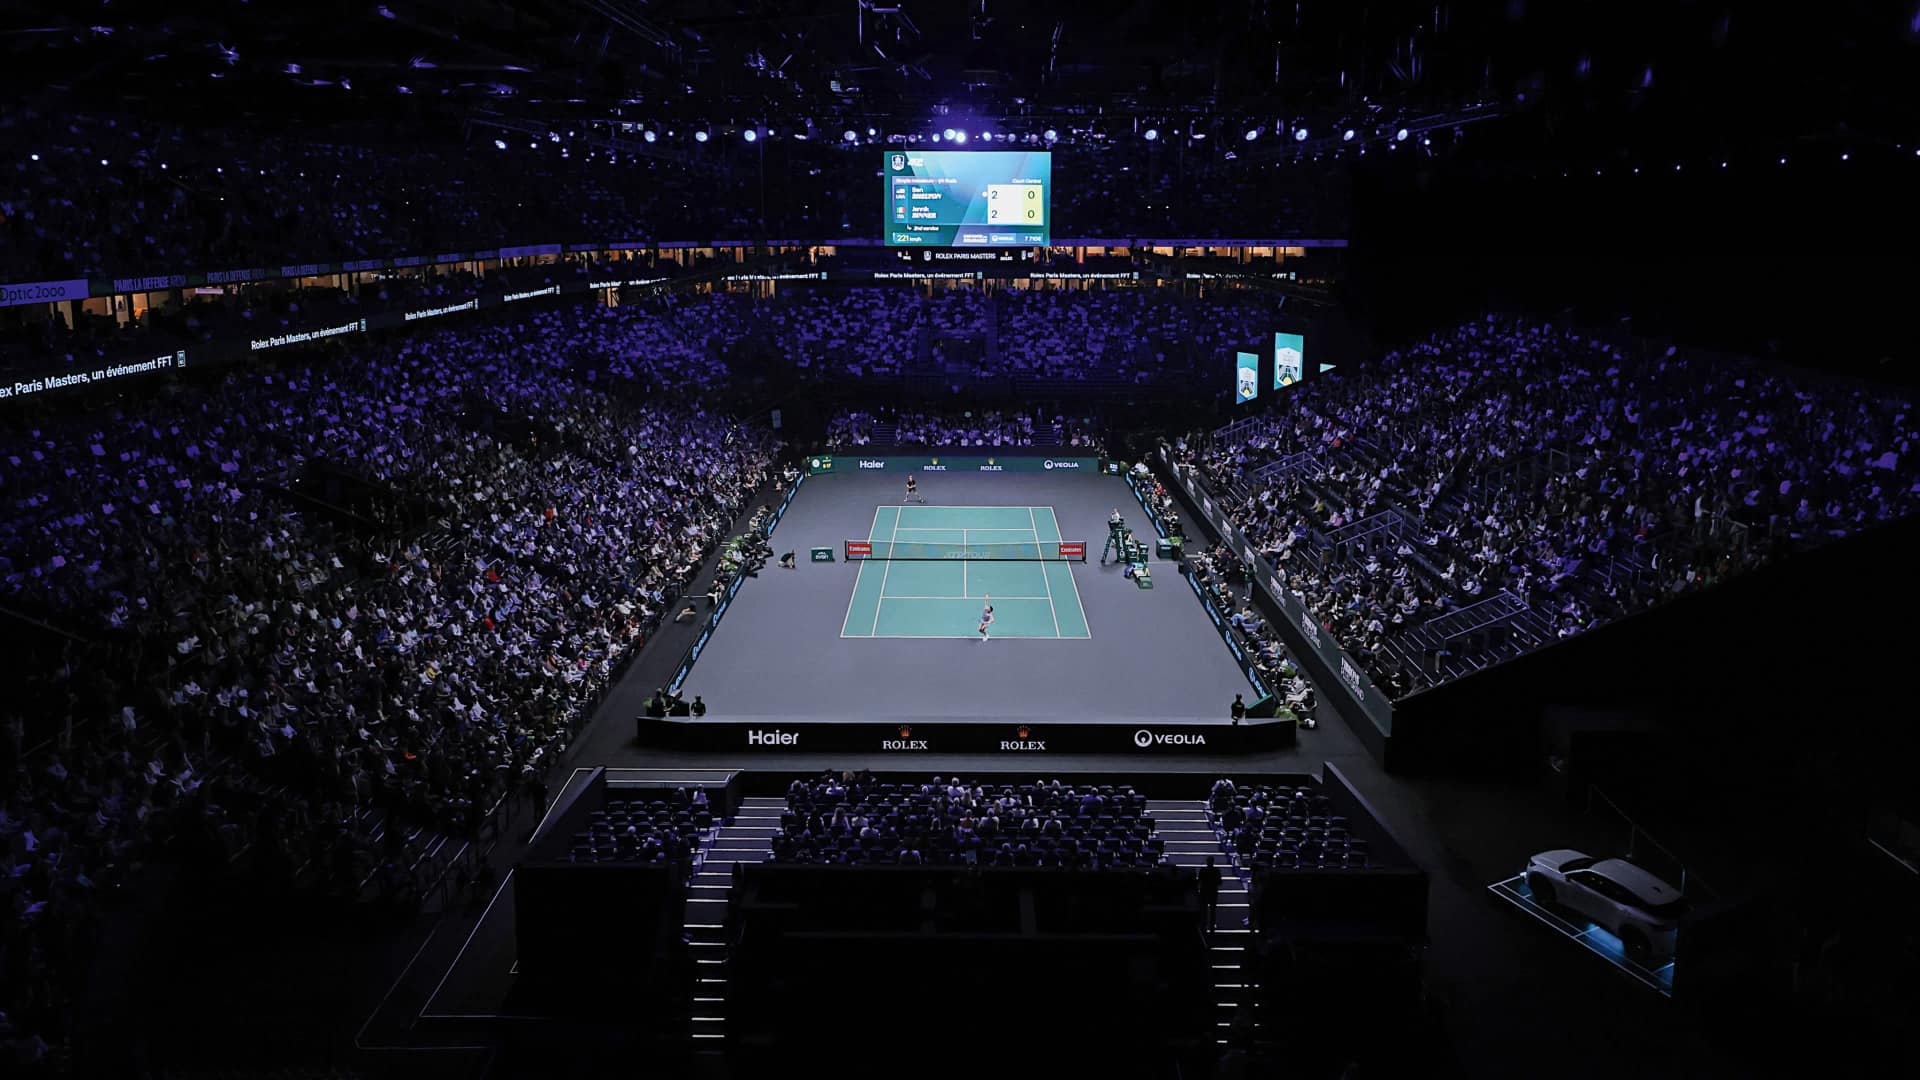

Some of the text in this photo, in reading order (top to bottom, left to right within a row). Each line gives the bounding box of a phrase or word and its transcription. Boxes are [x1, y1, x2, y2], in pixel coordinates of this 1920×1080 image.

[992, 191, 1035, 199] 2 0
[991, 210, 1034, 218] 2 0
[936, 252, 996, 260] ROLEX PARIS MASTERS
[114, 279, 132, 293] PARIS
[35, 286, 65, 299] 2000
[251, 338, 269, 351] Rolex
[270, 335, 285, 347] Paris
[286, 331, 312, 344] Masters,
[312, 330, 319, 339] un
[349, 321, 359, 332] FFT
[15, 379, 43, 396] Paris
[45, 371, 90, 391] Masters,
[92, 369, 104, 382] un
[106, 359, 156, 380] événement
[157, 355, 173, 369] FFT
[860, 460, 884, 469] Haier
[749, 730, 798, 745] Haier
[1155, 734, 1206, 745] VEOLIA
[883, 741, 928, 750] ROLEX
[1001, 741, 1045, 750] ROLEX
